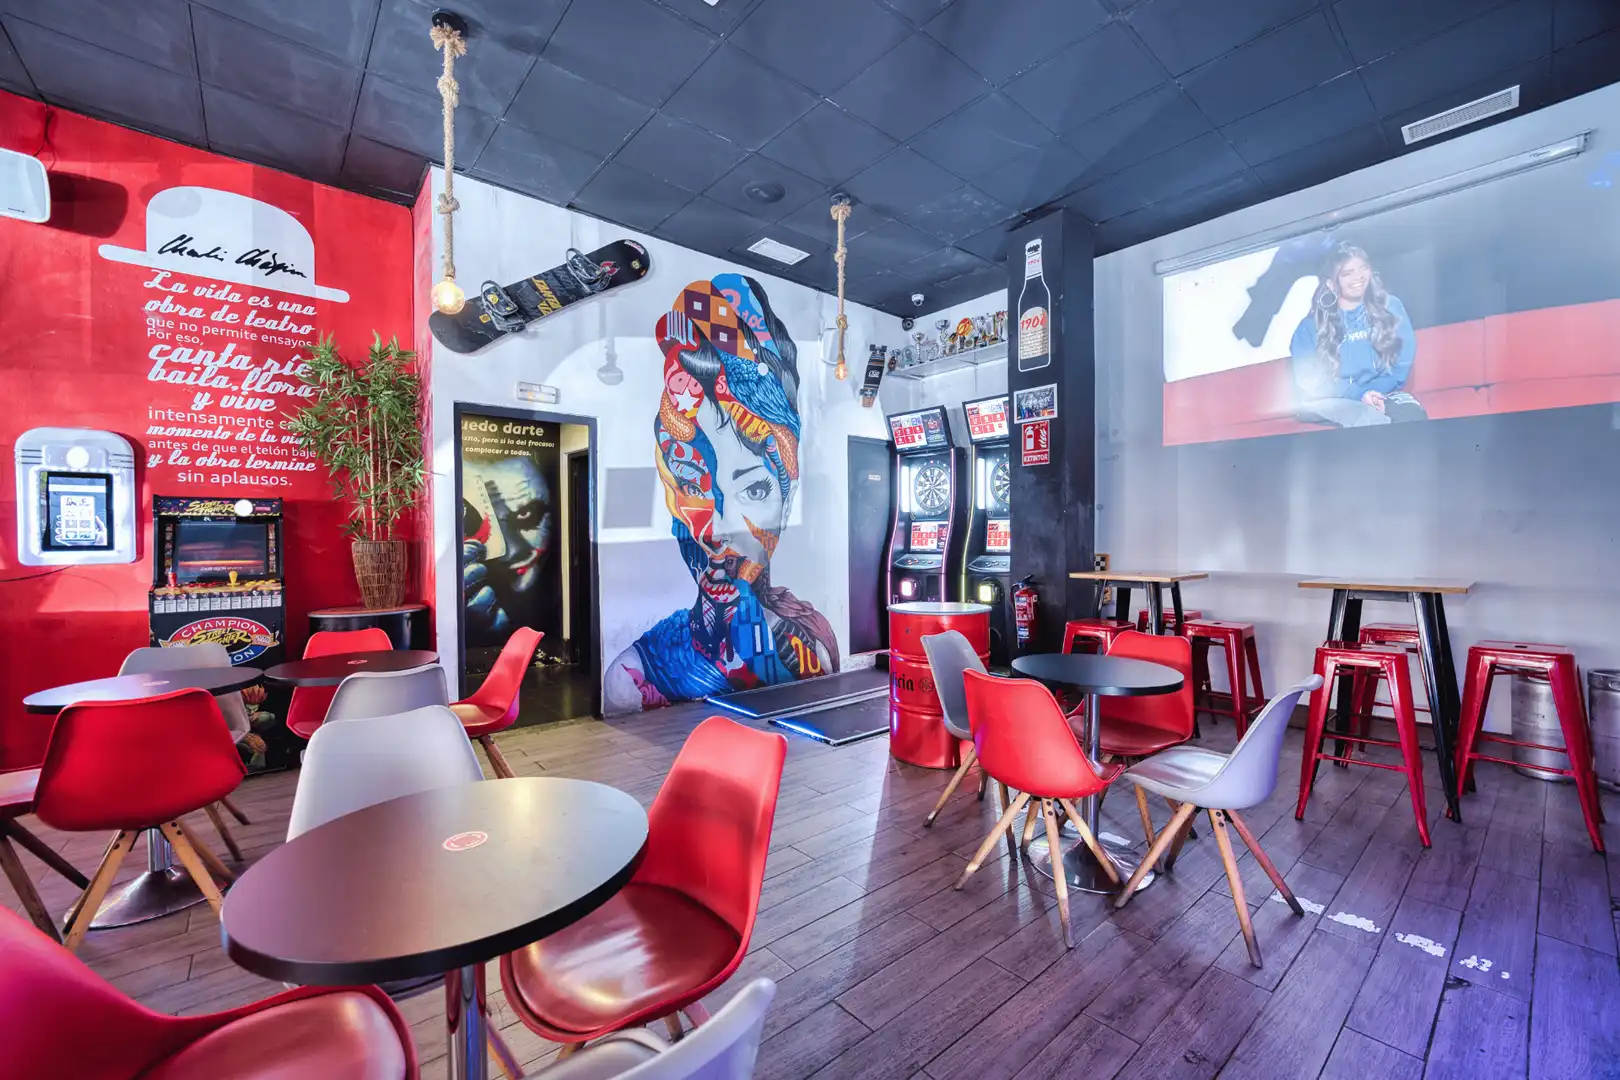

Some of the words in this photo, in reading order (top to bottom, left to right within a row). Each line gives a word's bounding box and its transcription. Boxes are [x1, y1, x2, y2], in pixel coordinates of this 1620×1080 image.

[143, 269, 188, 294] La
[193, 284, 243, 303] vida
[248, 295, 273, 308] es
[277, 300, 317, 316] una
[144, 296, 206, 319] obra
[211, 305, 240, 324] de
[244, 310, 316, 335] teatro
[146, 317, 175, 334] que
[179, 322, 198, 332] no
[202, 325, 257, 341] permite
[147, 328, 172, 340] Por
[175, 334, 204, 346] eso,
[191, 391, 214, 412] y
[220, 391, 277, 412] vive
[148, 406, 274, 430] intensamente
[146, 425, 233, 441] momento
[235, 428, 257, 442] de
[260, 430, 279, 444] tu
[503, 422, 544, 437] darte
[148, 439, 188, 451] antes
[192, 440, 208, 452] de
[212, 444, 237, 457] que
[240, 445, 252, 454] el
[256, 445, 288, 457] telón
[292, 447, 317, 460] baje
[465, 447, 503, 455] complacer
[147, 452, 164, 468] y
[168, 450, 191, 466] la
[195, 452, 242, 469] obra
[245, 454, 317, 472] termine
[177, 470, 204, 483] sin
[210, 471, 292, 487] aplausos.
[181, 620, 260, 638] CHAMPION
